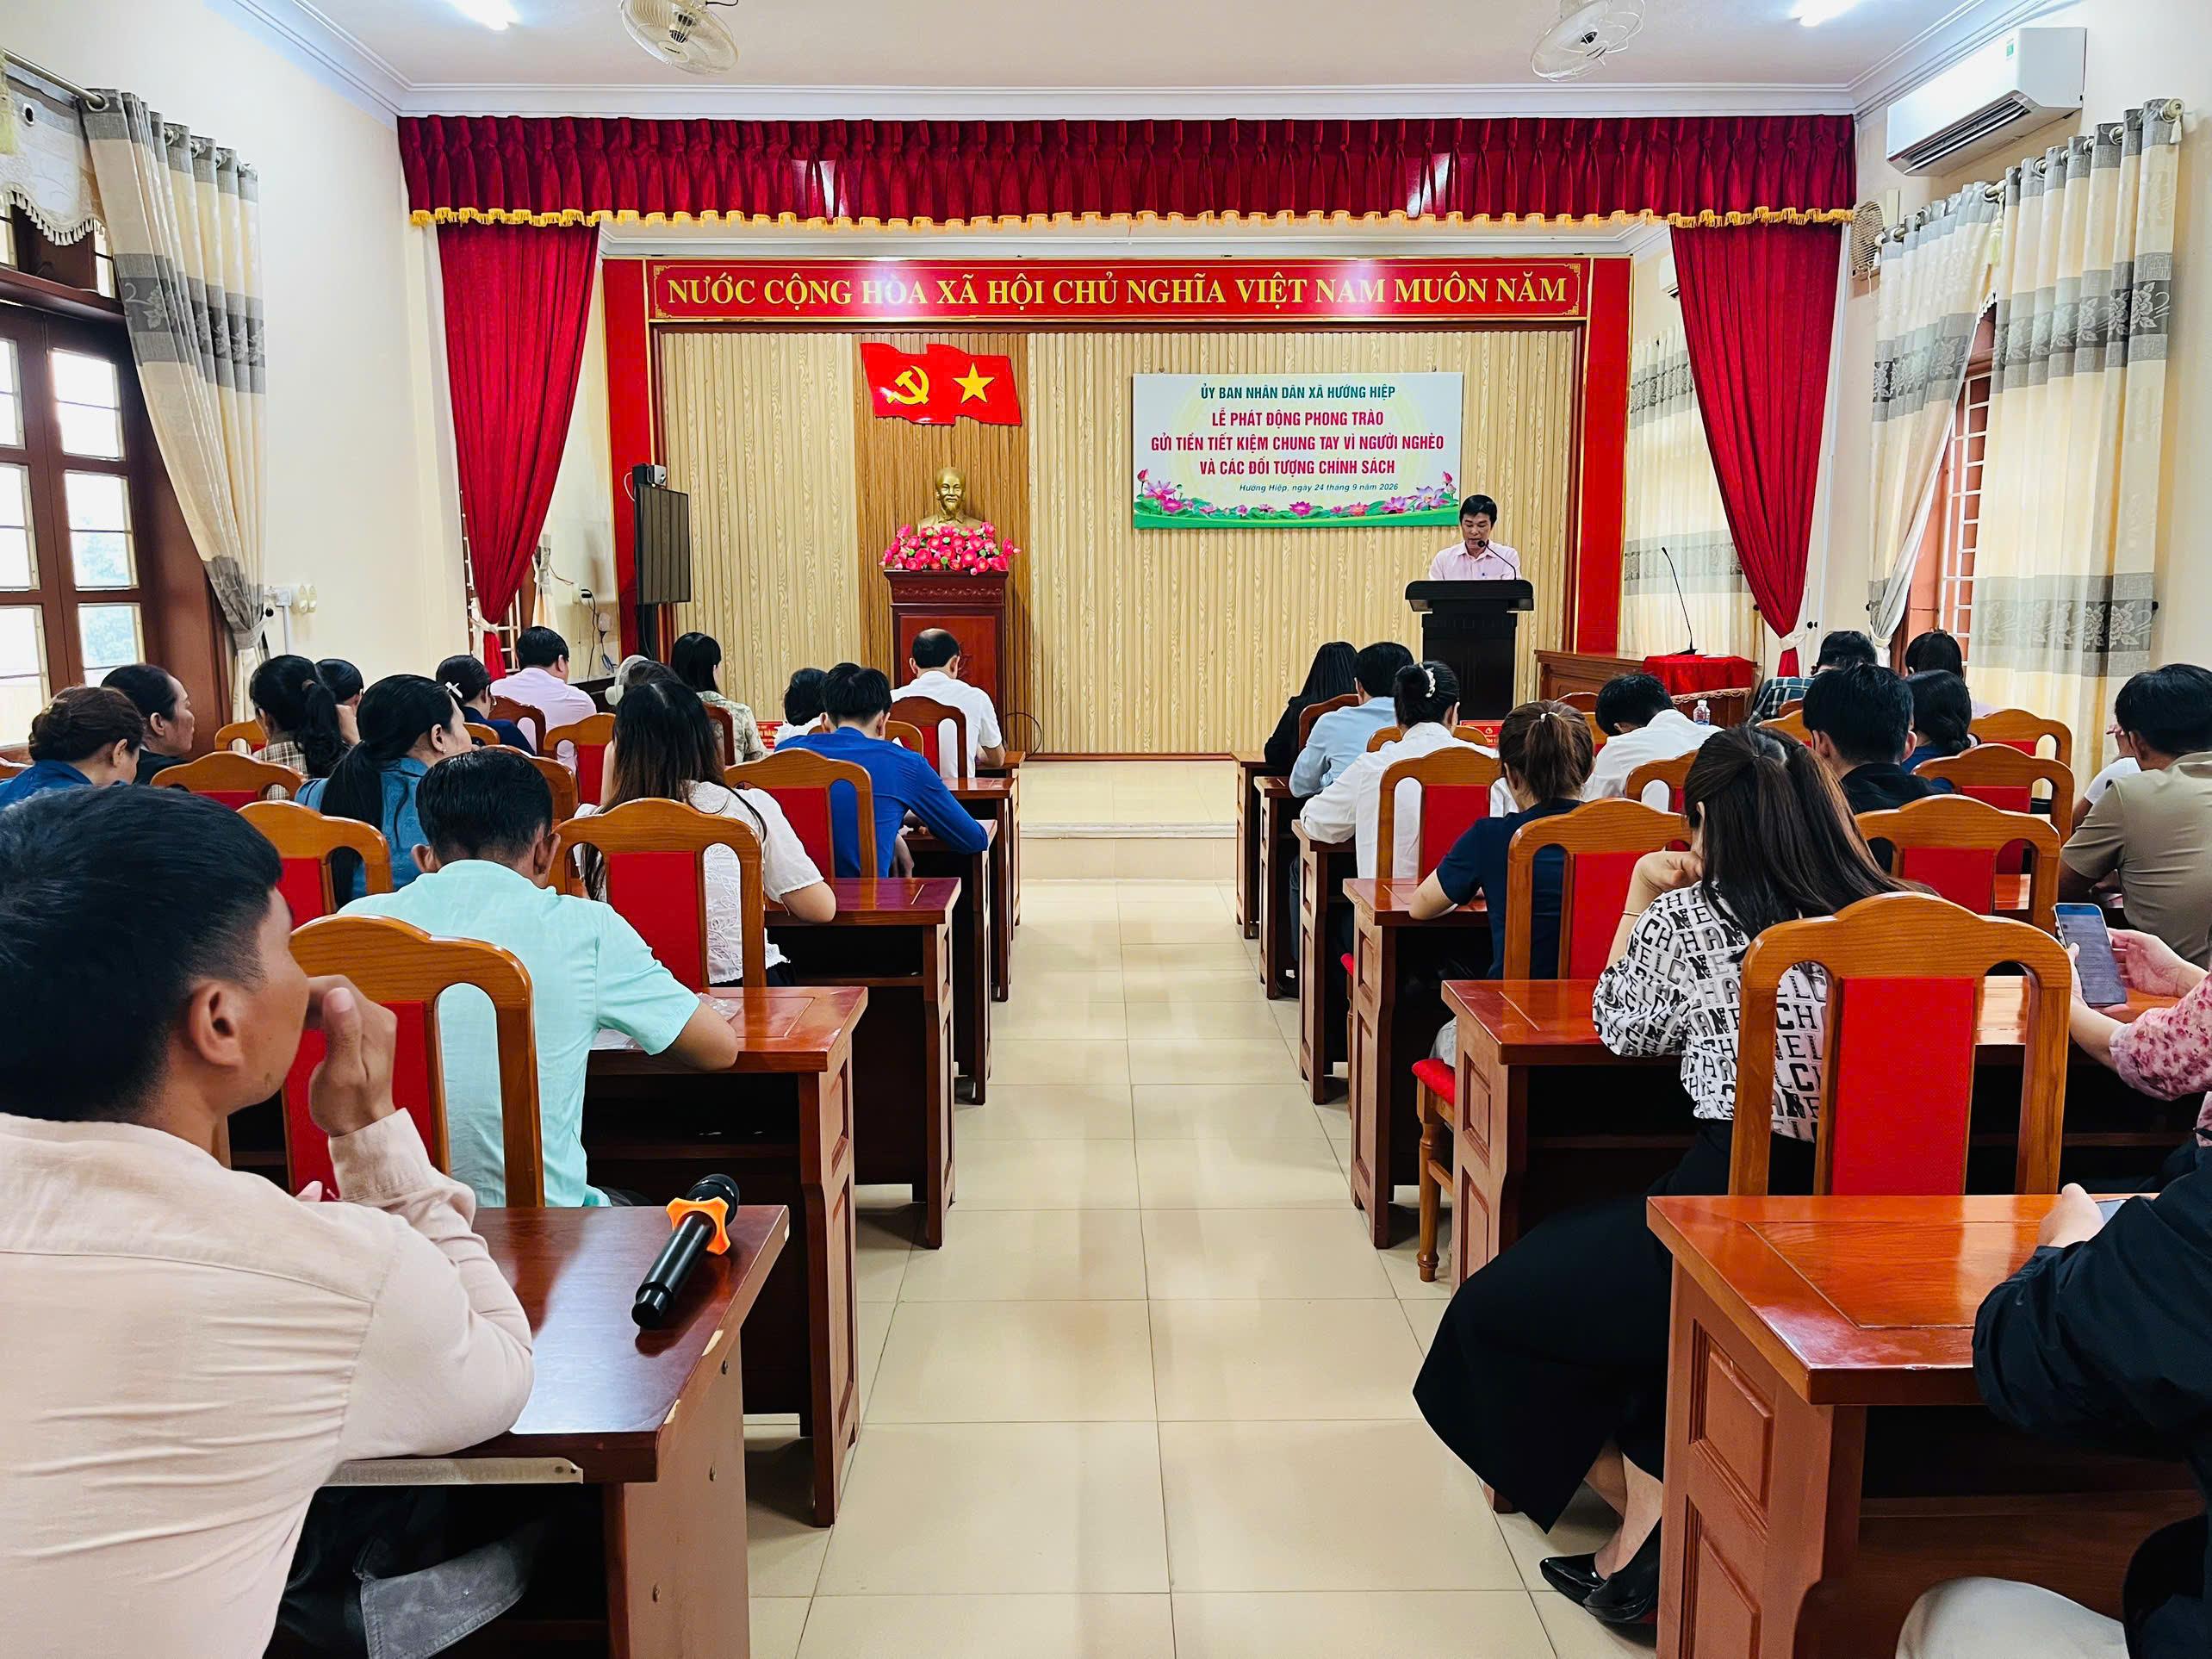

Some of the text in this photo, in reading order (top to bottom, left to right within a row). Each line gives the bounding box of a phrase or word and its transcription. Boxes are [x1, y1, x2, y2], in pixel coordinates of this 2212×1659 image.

[668, 270, 1568, 311] NƯỚC CỘNG HÒA XÃ HỘI CHỦ NGHĨA VIỆT NAM MUÔN NĂM
[1201, 382, 1395, 401] ỦY BAN NHÂN DÂN XÃ HƯỚNG HIỆP
[1212, 407, 1383, 429] LỄ PHÁT ĐỘNG PHONG TRÀO
[1151, 432, 1445, 454] GỬI TIỀN TIẾT KIỆM CHUNG TAY VÌ NGƯỜI NGHÈO
[1200, 456, 1395, 478] VÀ CÁC ĐỐI TƯỢNG CHÍNH SÁCH
[1352, 482, 1358, 491] 9
[1379, 482, 1399, 491] 2026
